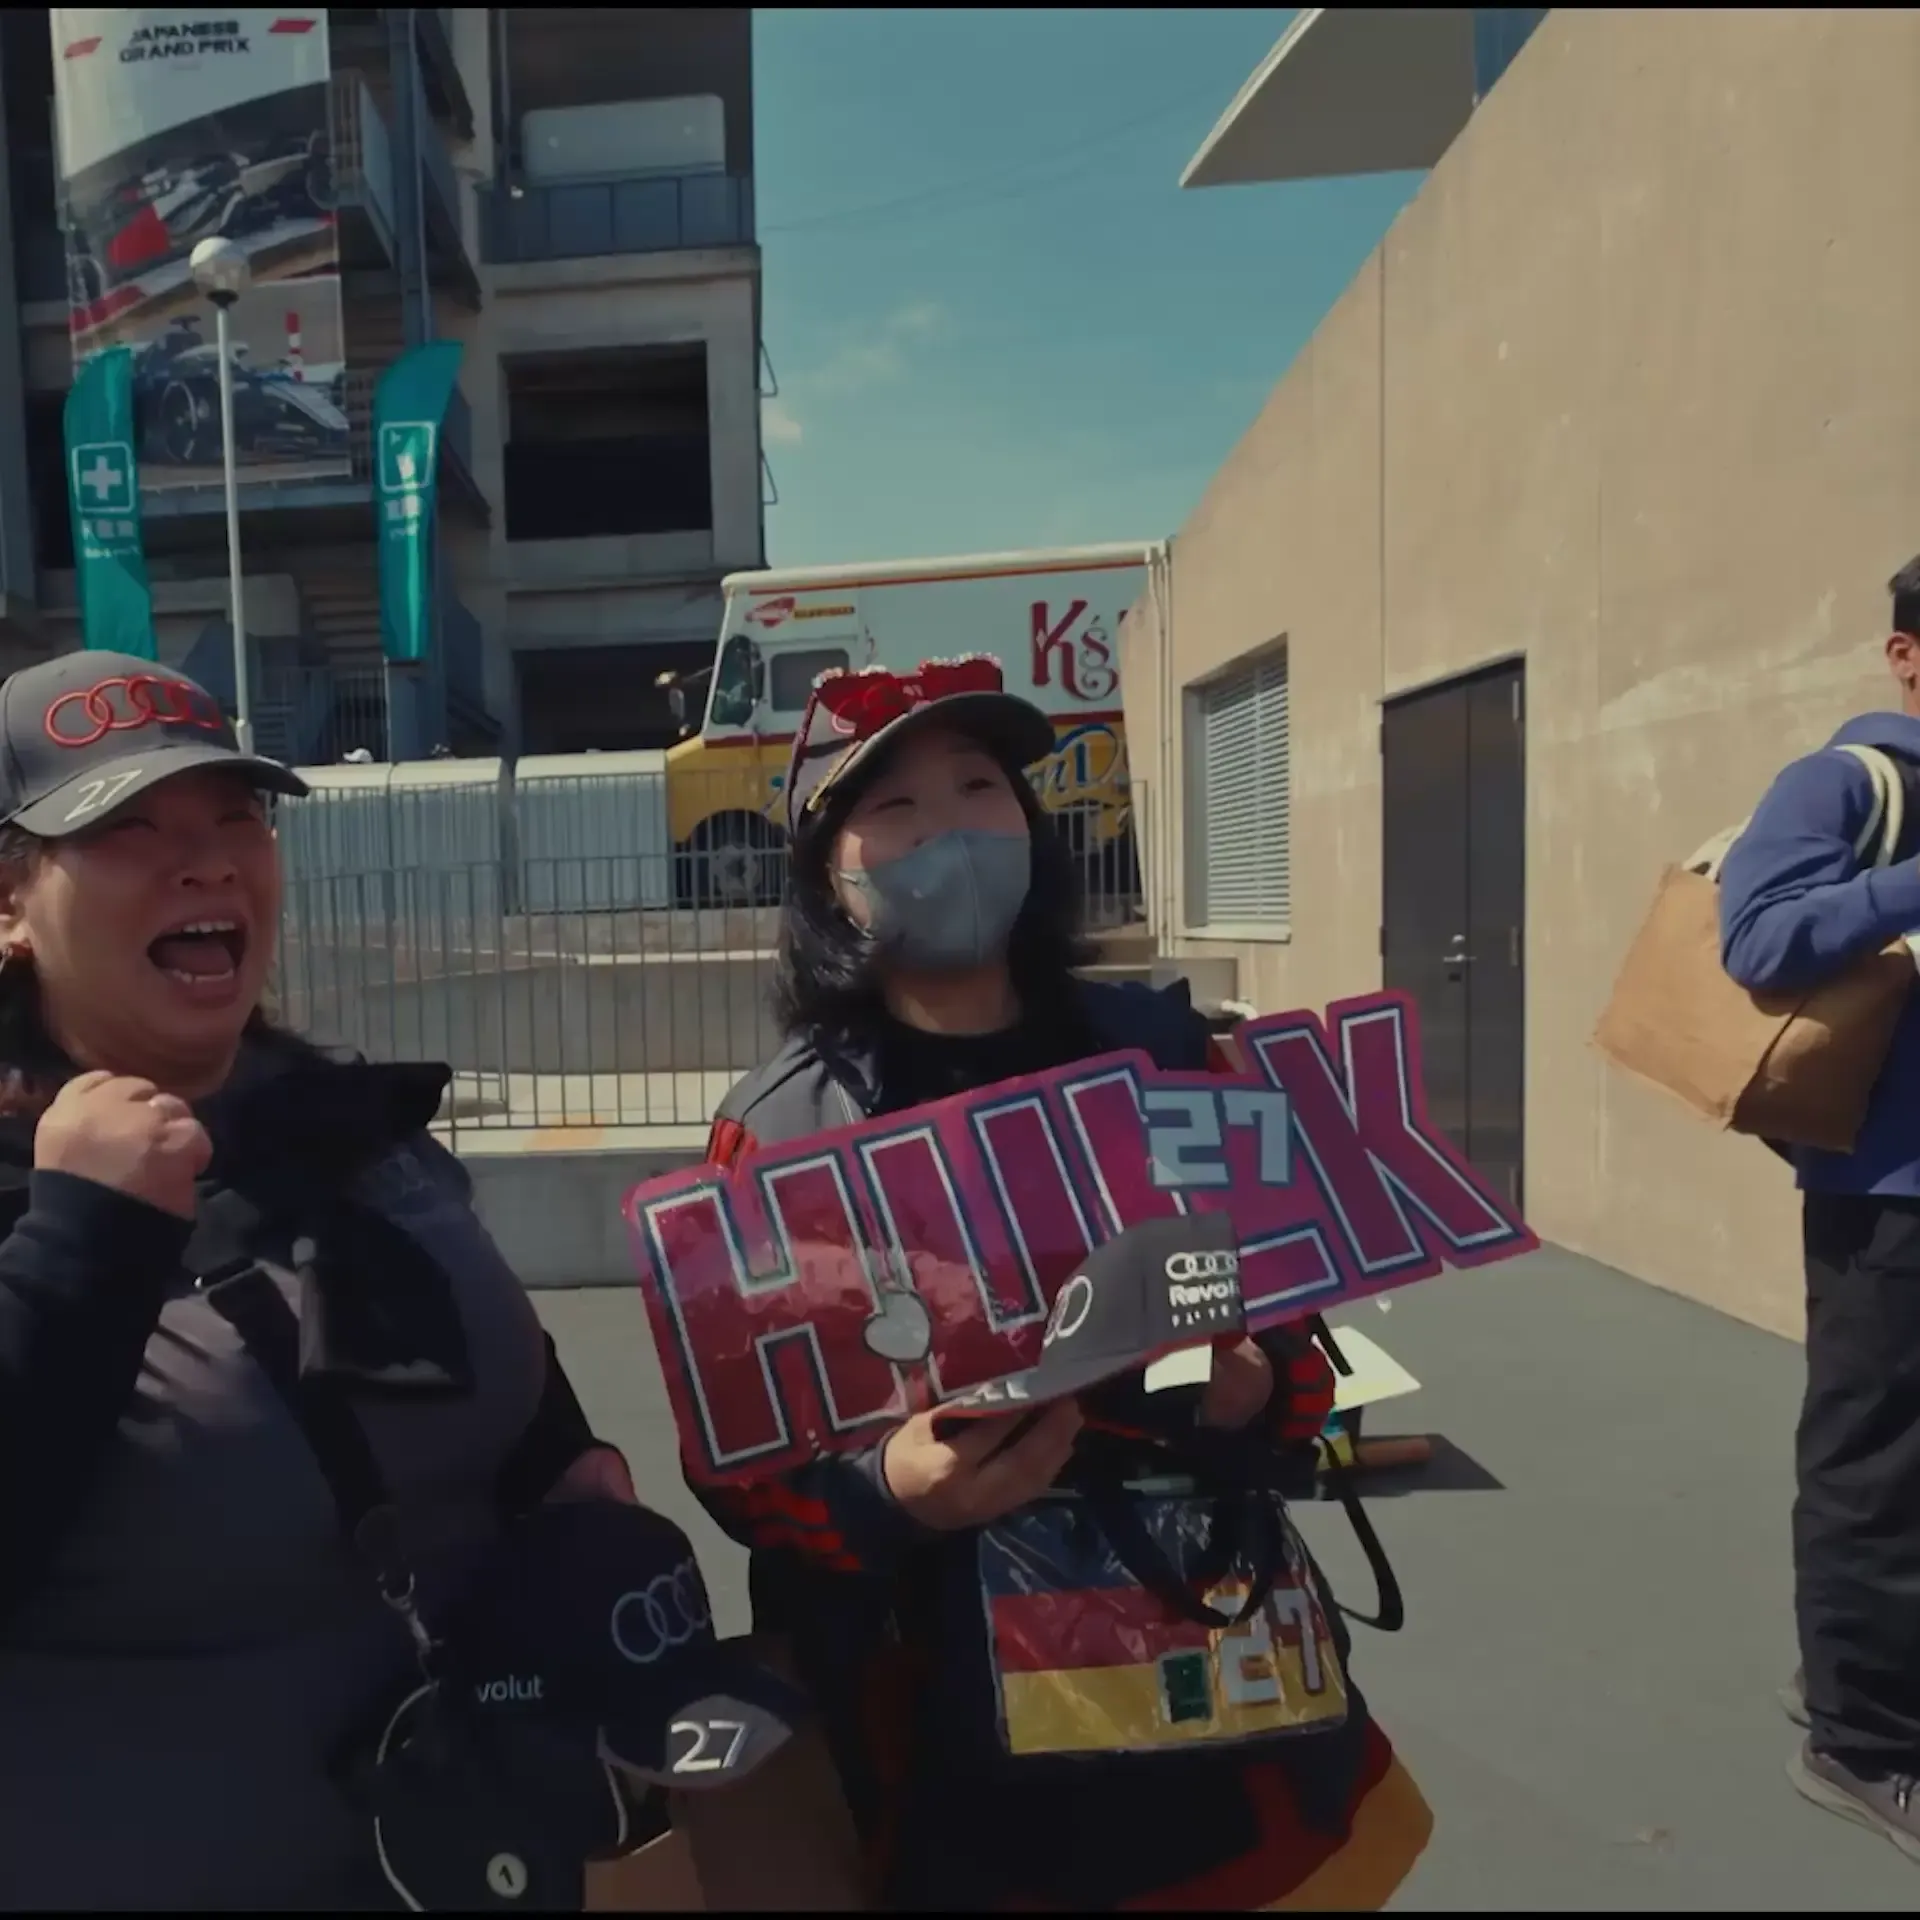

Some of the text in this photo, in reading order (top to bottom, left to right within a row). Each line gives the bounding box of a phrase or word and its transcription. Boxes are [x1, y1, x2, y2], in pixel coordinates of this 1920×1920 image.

[119, 37, 250, 63] GRAND PRIX
[129, 20, 240, 44] JAPANESE
[63, 768, 143, 823] 27
[1143, 1090, 1290, 1187] 27
[640, 1003, 1522, 1472] HULK
[670, 1719, 748, 1774] 27
